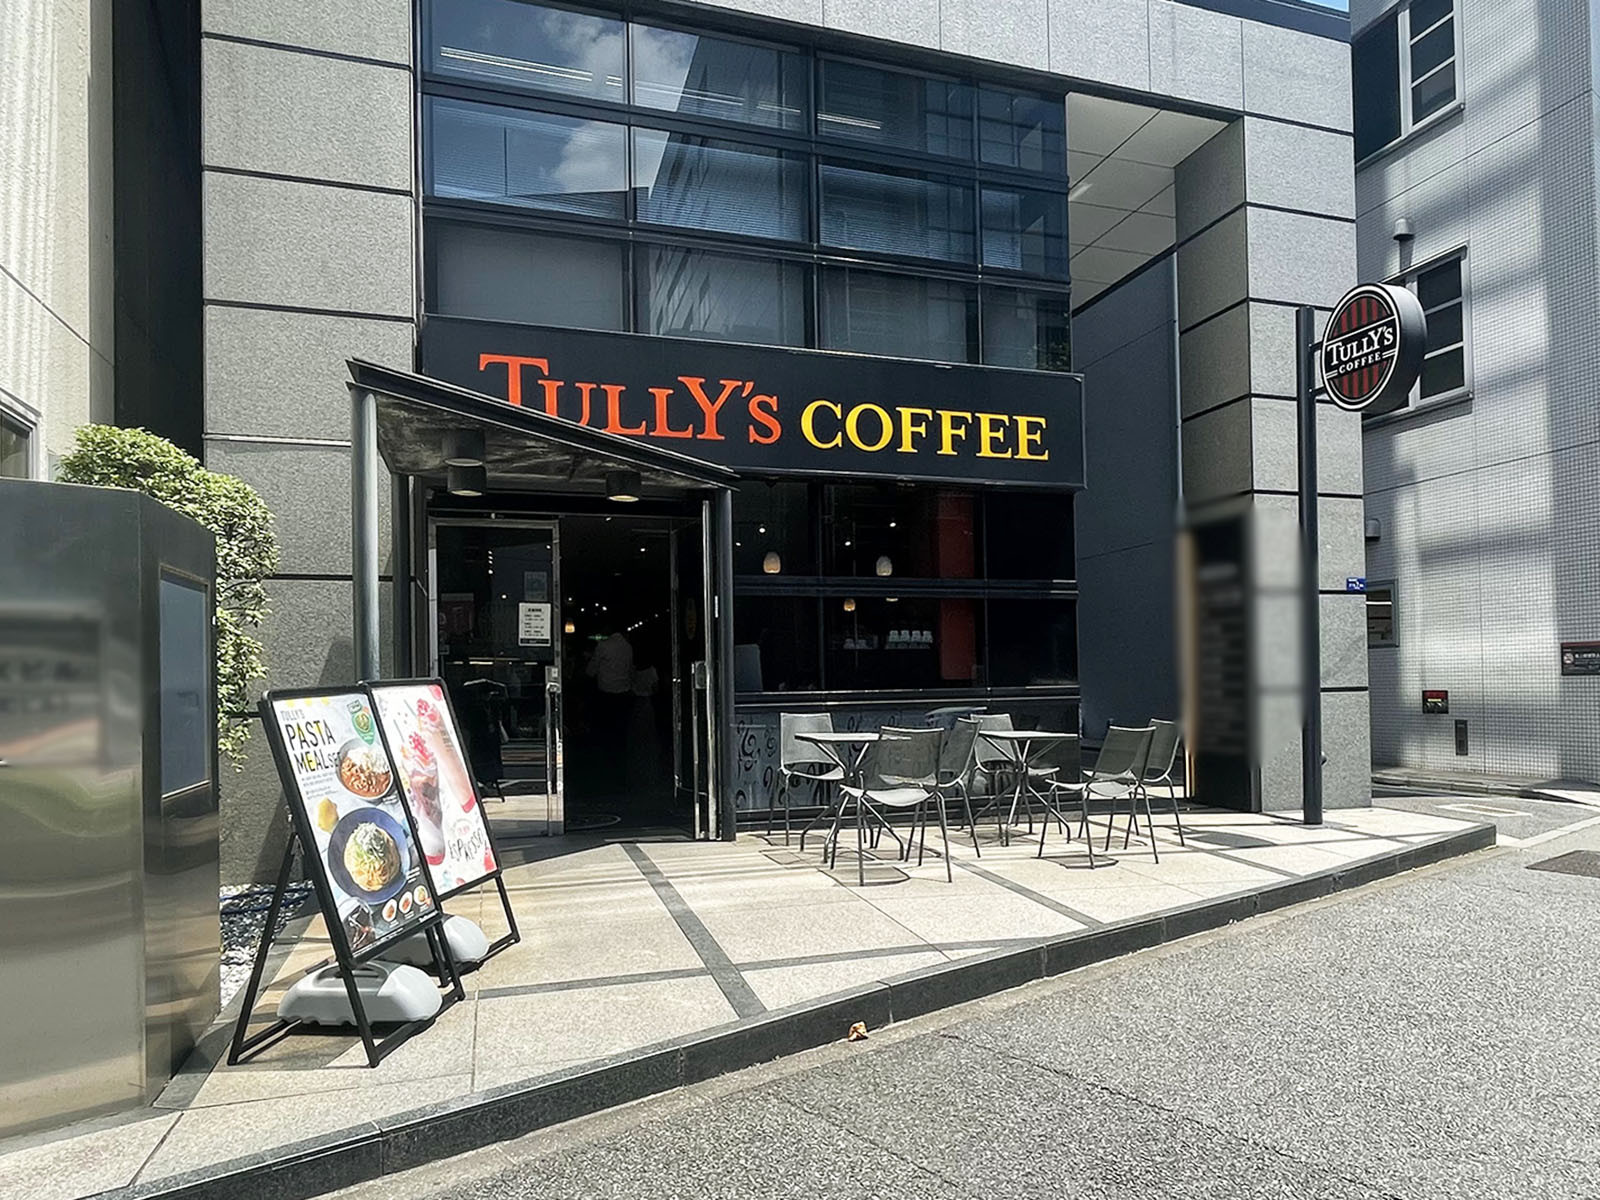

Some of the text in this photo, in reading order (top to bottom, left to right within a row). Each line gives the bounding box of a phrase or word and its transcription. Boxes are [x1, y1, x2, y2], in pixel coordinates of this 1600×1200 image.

[1327, 326, 1394, 366] TULLY'S
[1338, 351, 1382, 374] COFFEE
[800, 399, 1050, 462] COFFEE
[285, 719, 337, 751] PASTA
[293, 749, 330, 775] MEAL
